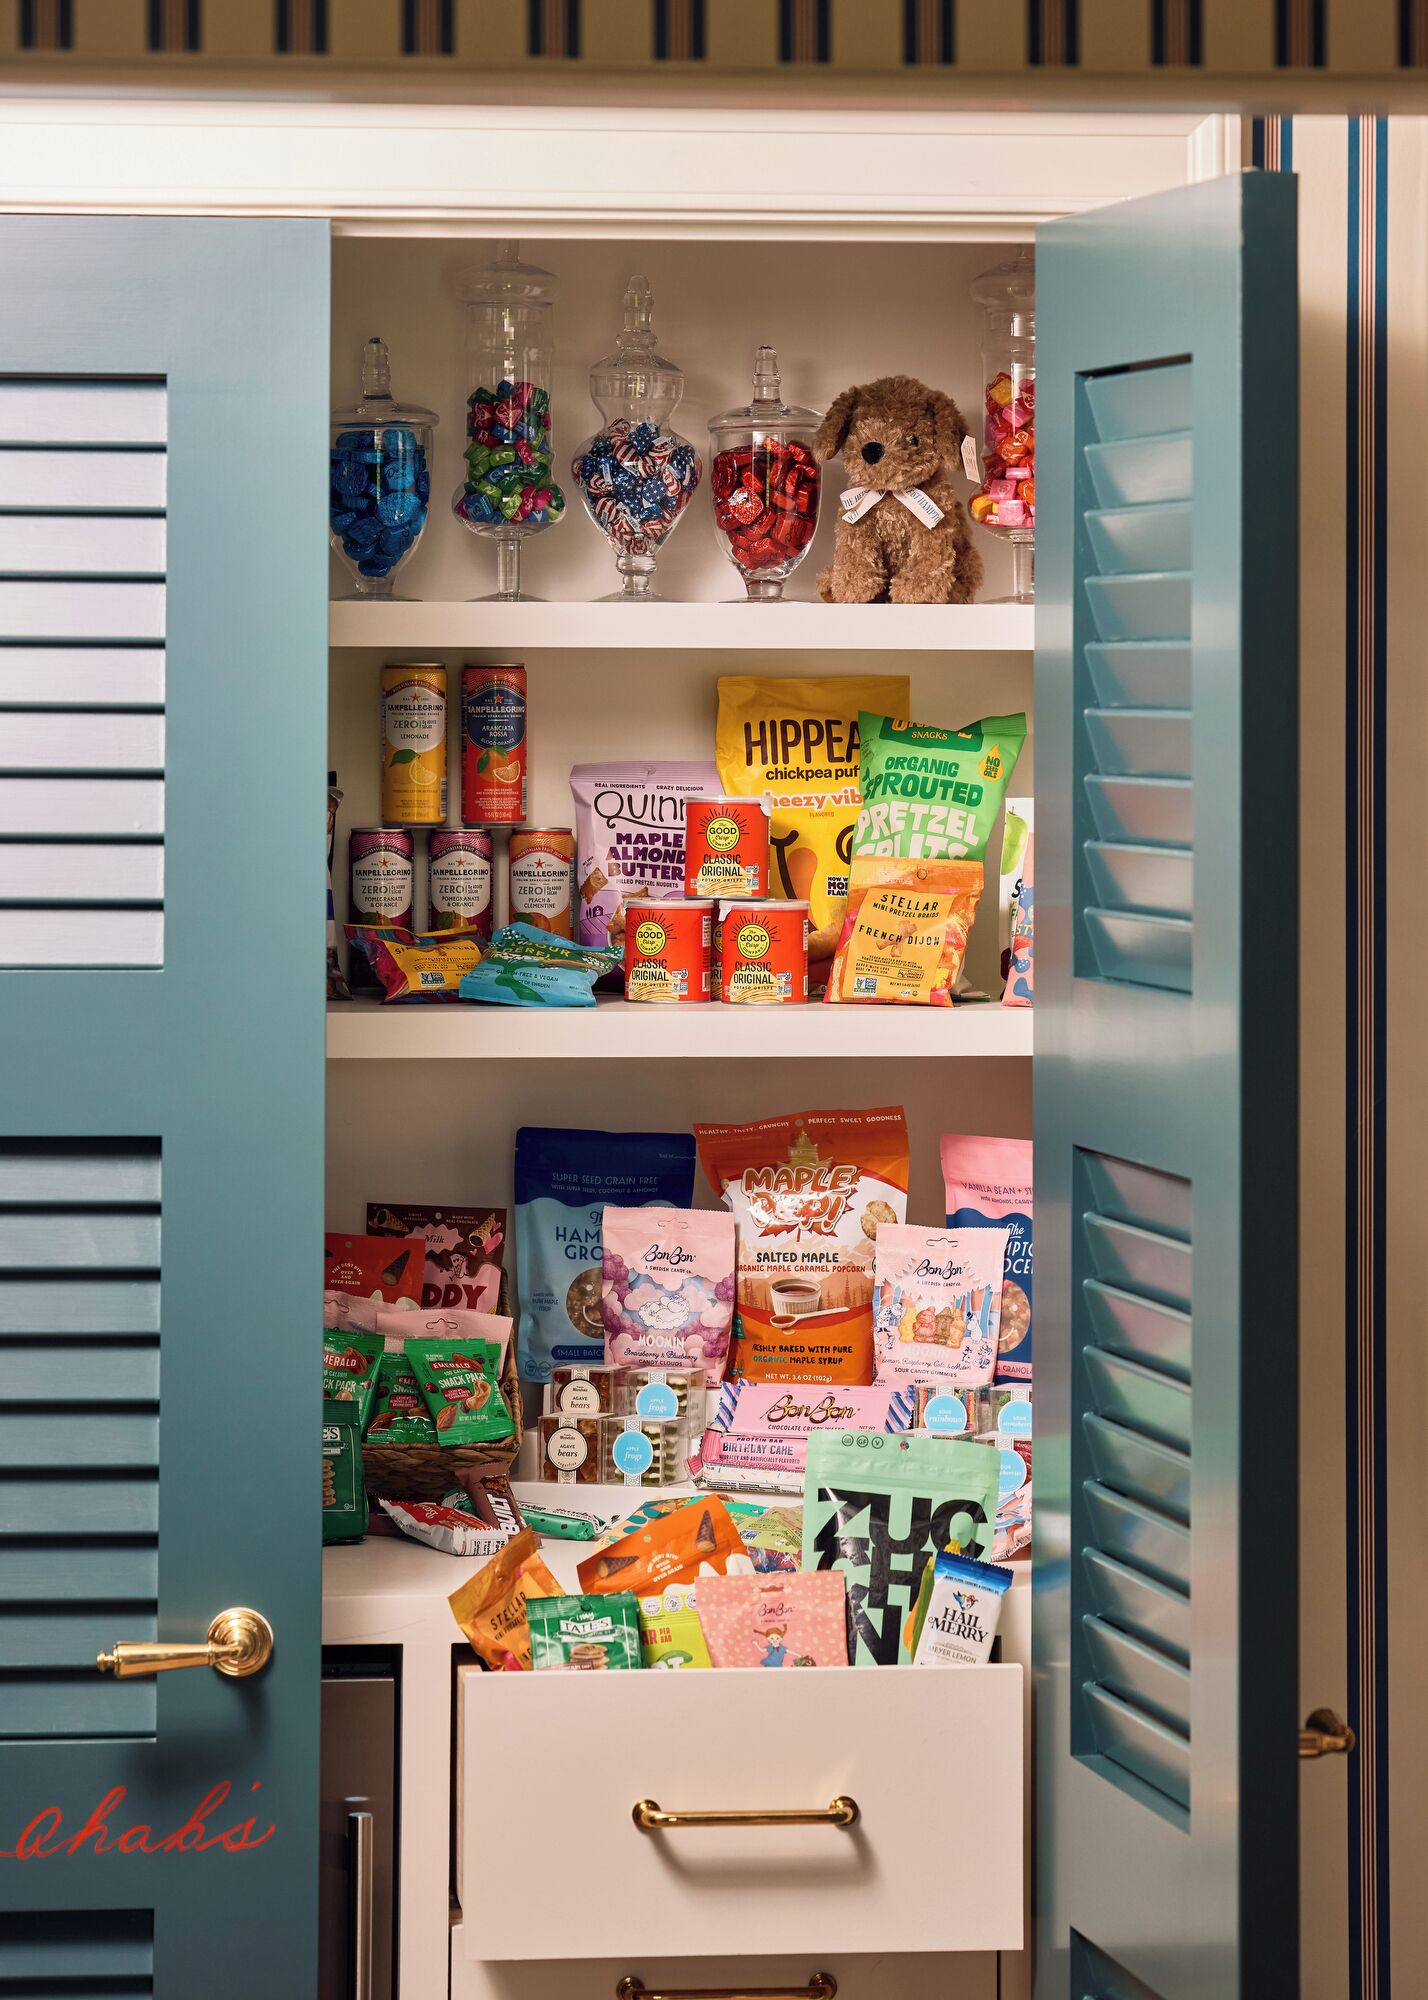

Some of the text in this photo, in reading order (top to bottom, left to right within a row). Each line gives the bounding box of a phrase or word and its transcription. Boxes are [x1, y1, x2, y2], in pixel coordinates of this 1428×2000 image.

[393, 720, 419, 729] ZERO
[911, 731, 948, 741] SNACKS
[885, 756, 960, 778] ORGANIC
[986, 756, 1000, 767] NO
[766, 766, 831, 781] chickpea
[863, 772, 983, 807] SPROUTED
[855, 801, 980, 847] PRETZEL
[616, 833, 684, 848] MAPLE
[605, 847, 686, 864] ALMOND
[704, 853, 742, 865] CLASSIC
[608, 863, 686, 881] BUTTER
[701, 866, 743, 877] ORIGINAL
[362, 885, 388, 894] ZERO
[439, 885, 465, 893] ZERO
[518, 886, 543, 895] ZERO
[881, 894, 939, 912] STELLAR
[873, 902, 887, 912] MINI
[889, 907, 916, 918] PRETZEL
[638, 931, 663, 939] GOOD
[740, 934, 767, 942] GOOD
[859, 925, 940, 946] FRENCH DIJON
[633, 957, 668, 969] CLASSIC
[735, 961, 772, 972] CLASSIC
[631, 969, 669, 982] ORIGINAL
[733, 973, 774, 985] ORIGINAL
[759, 1121, 790, 1131] CRUNCHY
[866, 1114, 902, 1123] GOODNESS
[552, 1172, 658, 1185] SUPER SEED GRAIN FREE
[741, 1166, 859, 1195] MAPLE
[961, 1182, 1016, 1195] VANILLA BEAN
[1007, 1222, 1025, 1236] The
[425, 1234, 445, 1244] Milk
[641, 1244, 694, 1265] BonBon
[756, 1252, 839, 1265] SALTED MAPLE
[767, 1264, 866, 1273] MAPLE CARAMEL POPCORN
[914, 1258, 962, 1280] BonBon
[639, 1334, 685, 1349] MOOMIN
[557, 1348, 581, 1358] SMALL
[624, 1348, 660, 1360] Strawberry
[666, 1351, 698, 1362] Blueberry
[779, 1345, 806, 1353] BAKED
[833, 1346, 853, 1354] PURE
[433, 1362, 471, 1370] EMERALD
[752, 1355, 843, 1365] ORGANIC MAPLE SYRUP
[438, 1372, 487, 1389] SNACK PACK
[814, 1375, 833, 1383] (102g)
[930, 1370, 957, 1378] GUMMIES
[335, 1380, 356, 1393] PACK
[570, 1401, 590, 1409] bears
[648, 1404, 668, 1413] frogs
[760, 1394, 855, 1424] BonBon
[557, 1449, 578, 1457] bears
[723, 1442, 794, 1456] BIRTHDAY CAKE
[623, 1452, 643, 1462] frogs
[814, 1488, 988, 1558] ZUC
[656, 1559, 670, 1569] OVER
[660, 1564, 672, 1573] AND
[653, 1564, 684, 1583] OVER AGAIN
[758, 1603, 792, 1617] BonBon
[943, 1607, 983, 1629] HAIL
[564, 1620, 609, 1634] TATE'S
[659, 1627, 670, 1635] PER
[928, 1616, 989, 1644] MERRY
[661, 1634, 672, 1643] BAG
[928, 1645, 977, 1665] MEYER LEMON
